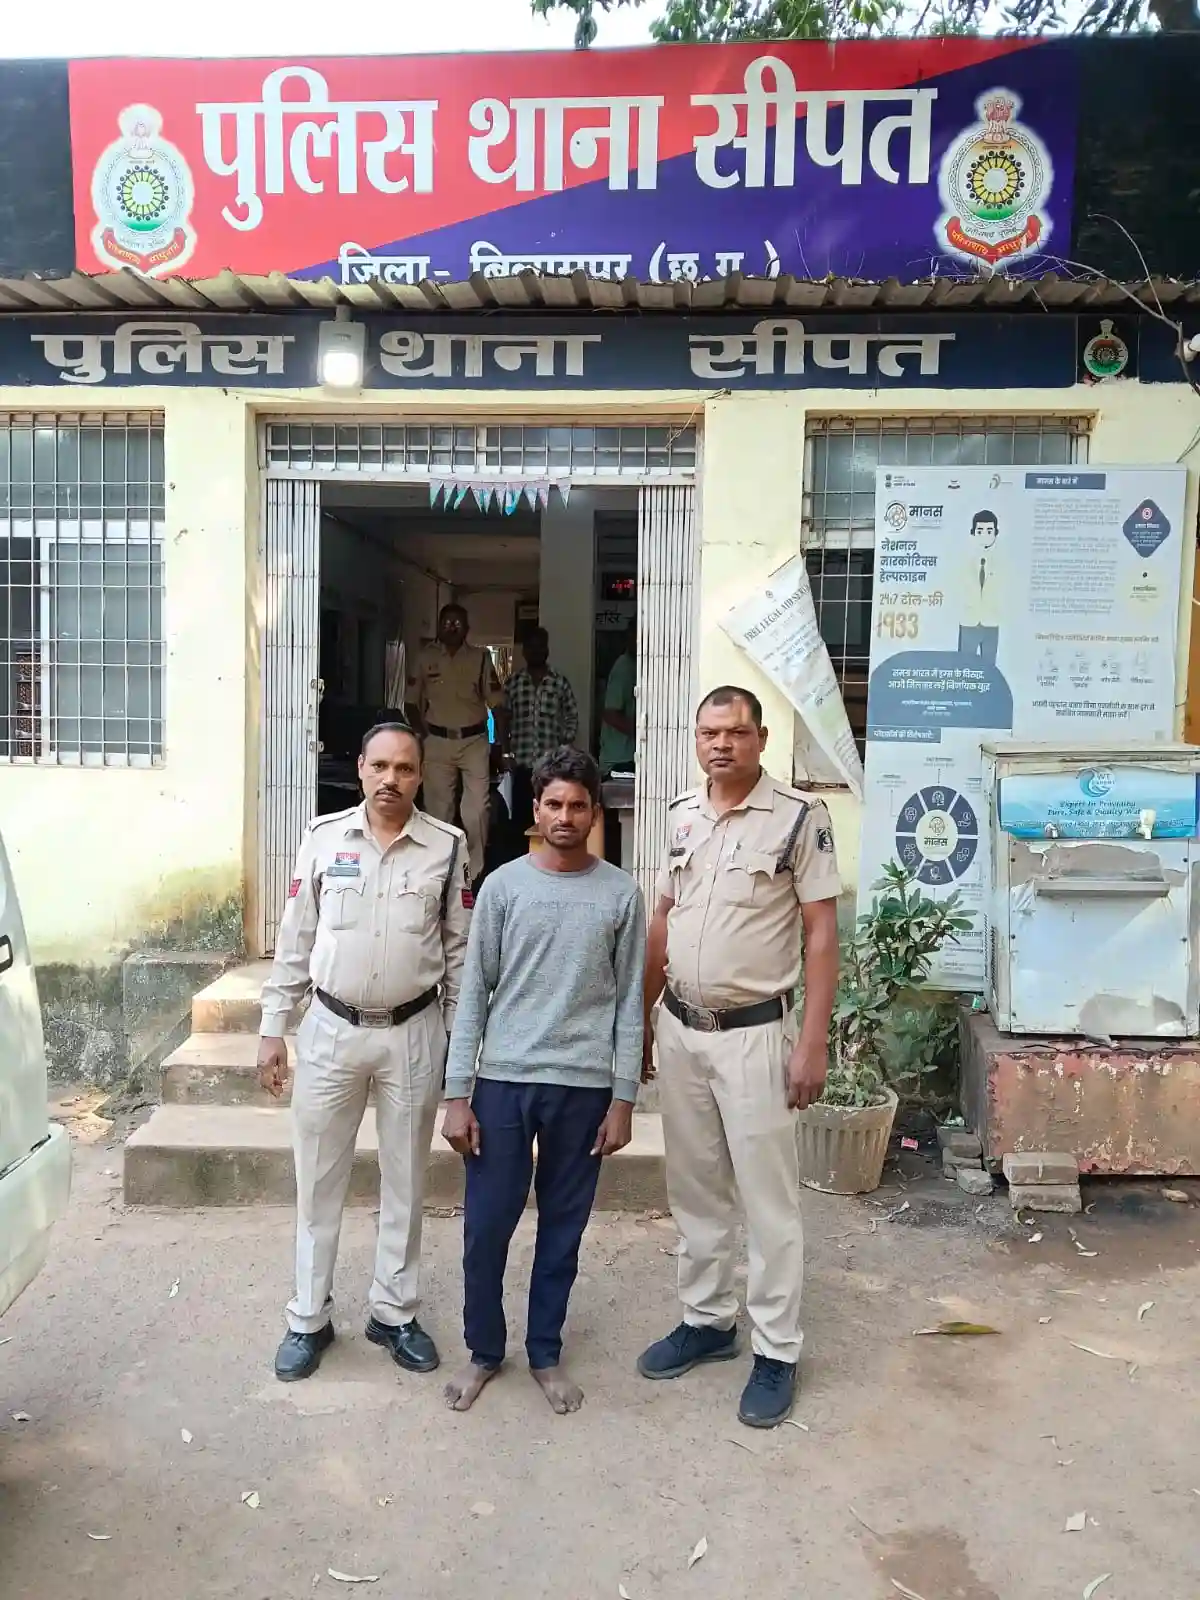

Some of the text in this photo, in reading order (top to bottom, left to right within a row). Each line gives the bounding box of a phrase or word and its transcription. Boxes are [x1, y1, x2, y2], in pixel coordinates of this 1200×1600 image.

[195, 55, 938, 232] पुलिस थाना सीपत
[469, 241, 632, 281] बिलासपर
[31, 319, 956, 383] पुलिस थाना सीपत
[909, 505, 944, 517] मानस
[881, 537, 917, 551] नेशनल
[880, 552, 938, 567] नारकोटिक्स
[879, 568, 927, 582] हेल्पलाइन
[900, 590, 944, 607] टोल-फ्री
[760, 609, 782, 631] LEGAL
[876, 611, 919, 640] 1933
[1060, 800, 1086, 809] Expert
[1094, 808, 1123, 817] Quality
[1125, 808, 1141, 816] Wat
[924, 837, 949, 847] मानस
